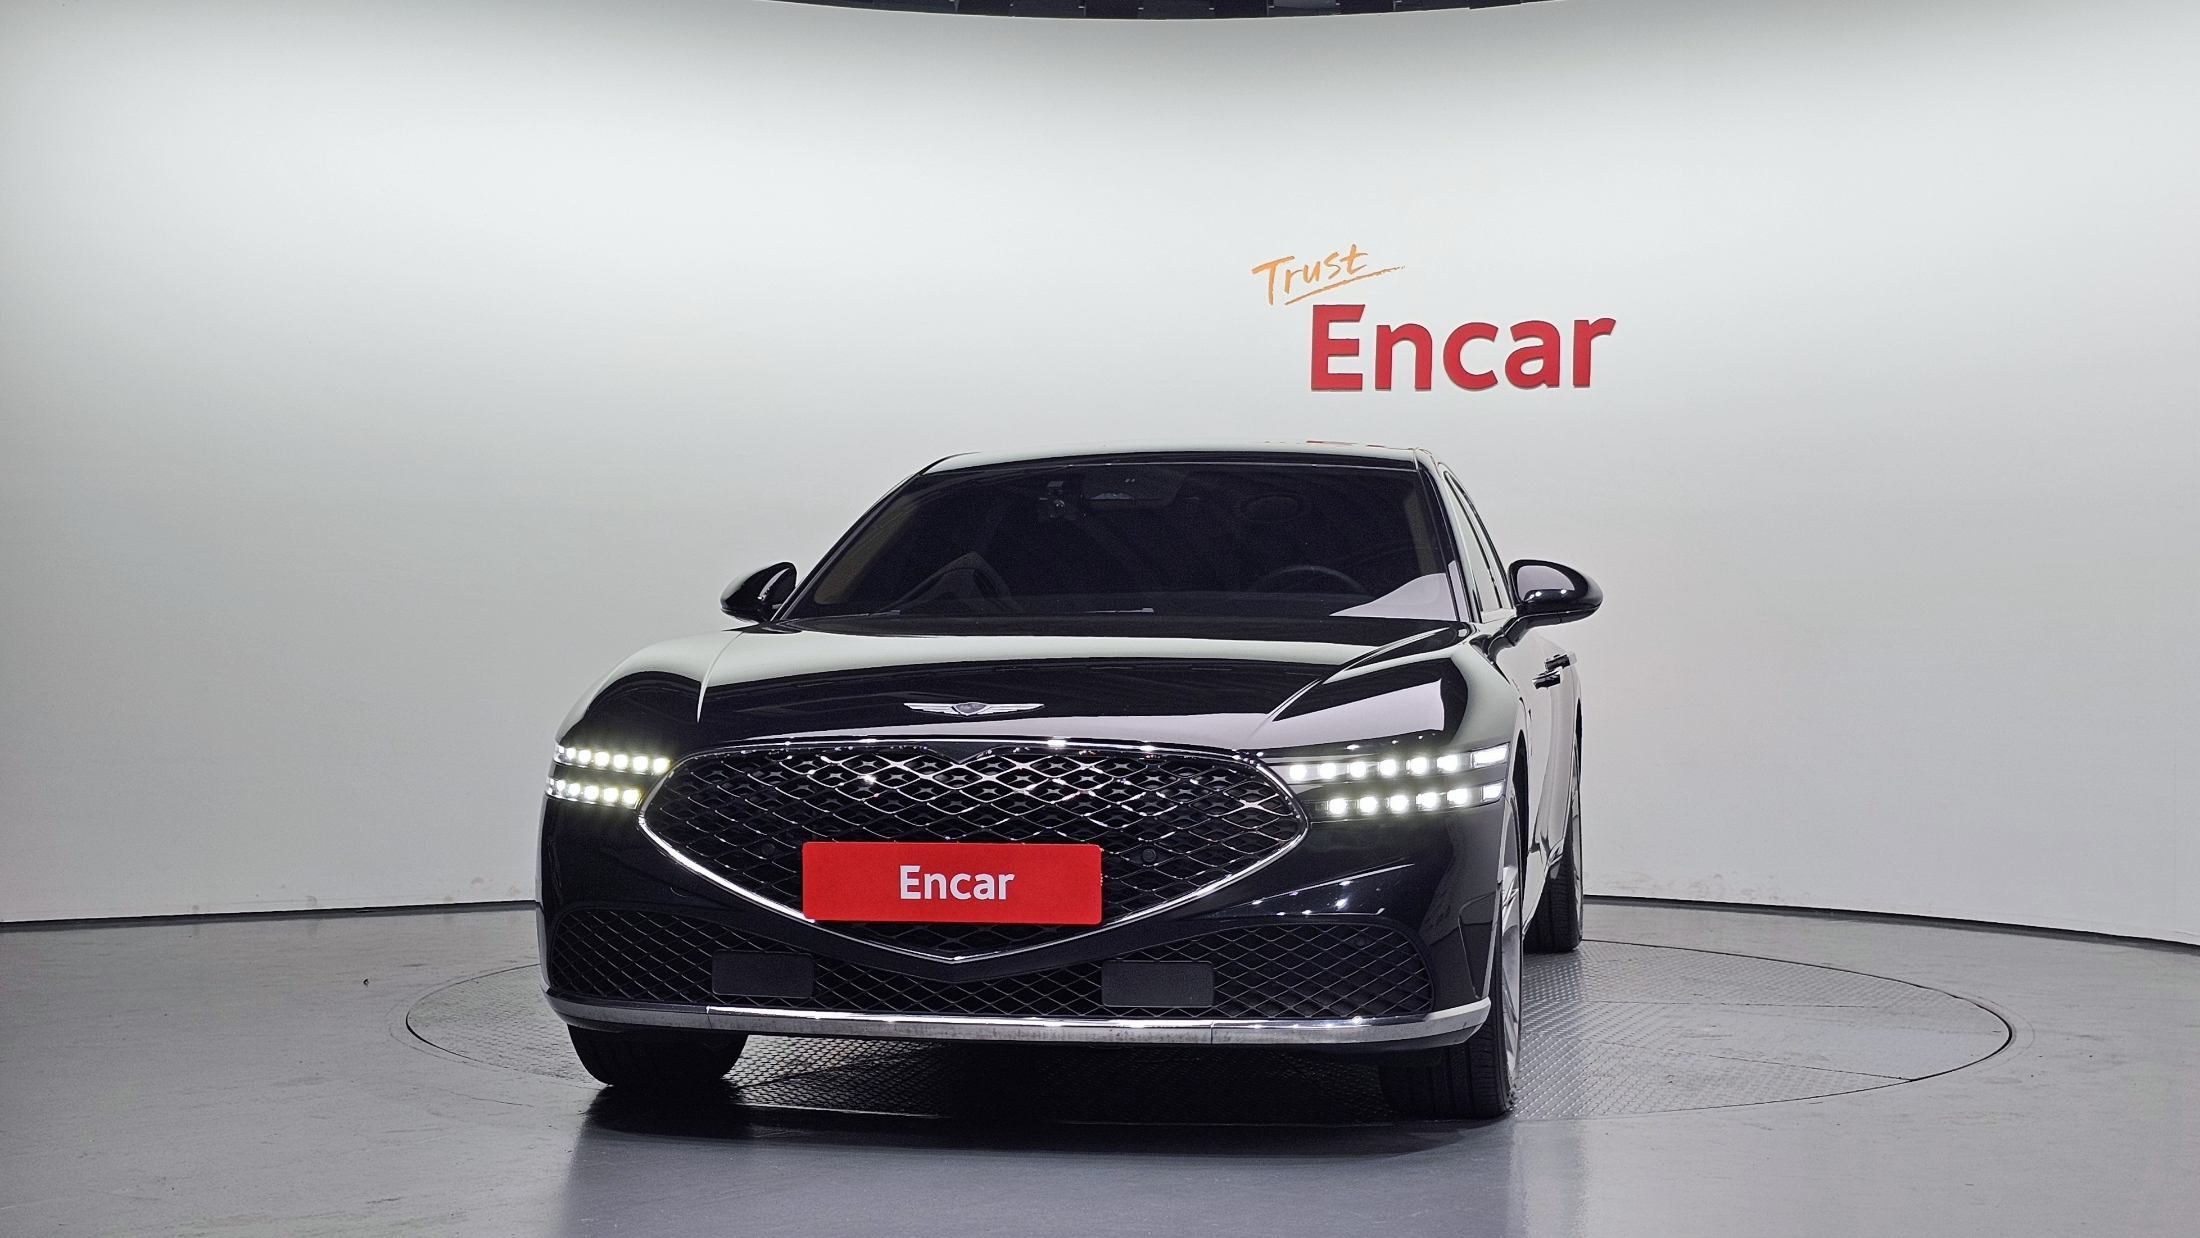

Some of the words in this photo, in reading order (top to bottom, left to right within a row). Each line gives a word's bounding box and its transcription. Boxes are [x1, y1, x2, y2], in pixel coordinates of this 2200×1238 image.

[1252, 244, 1368, 305] Trust
[1311, 304, 1616, 390] Encar
[900, 865, 1015, 900] Encar
